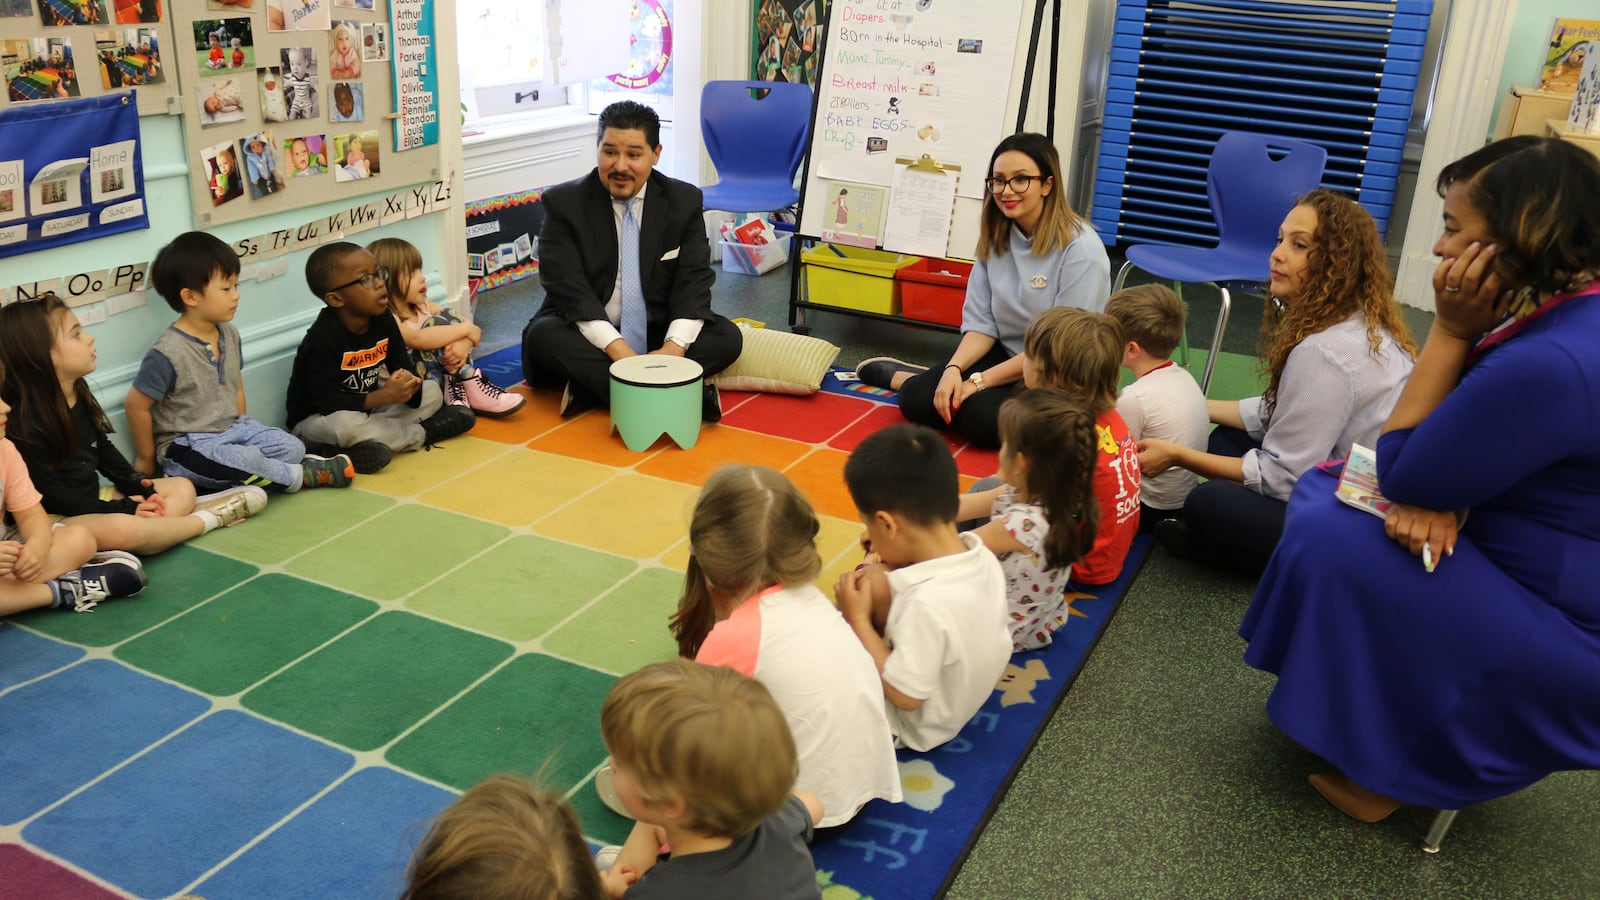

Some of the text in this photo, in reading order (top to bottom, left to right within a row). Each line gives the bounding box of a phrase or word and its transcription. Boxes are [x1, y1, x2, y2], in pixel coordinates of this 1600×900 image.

[397, 9, 421, 19] Arthur
[842, 6, 885, 24] Diapers
[397, 21, 417, 31] Louis
[398, 36, 430, 47] Thomas
[875, 33, 882, 41] in
[884, 32, 899, 43] the
[903, 34, 943, 51] Hospital
[400, 52, 425, 62] Parker
[872, 48, 906, 71] Tummy
[402, 82, 424, 93] Olivia
[402, 95, 431, 105] Eleanor
[402, 104, 429, 115] Dennis
[402, 114, 435, 126] Brandon
[403, 125, 423, 136] Louis
[404, 135, 424, 149] Elijah
[92, 150, 127, 169] Home
[108, 206, 135, 218] SUNDAY
[46, 218, 83, 232] SATURDAY
[68, 273, 103, 296] Oo
[114, 264, 144, 292] Pp
[238, 238, 258, 258] Ss
[272, 229, 291, 249] Tt
[297, 222, 319, 242] Uu
[328, 213, 343, 233] Vv
[350, 204, 376, 226] Ww
[384, 193, 402, 216] Xx
[412, 186, 427, 214] Yy
[435, 181, 451, 201] Zz
